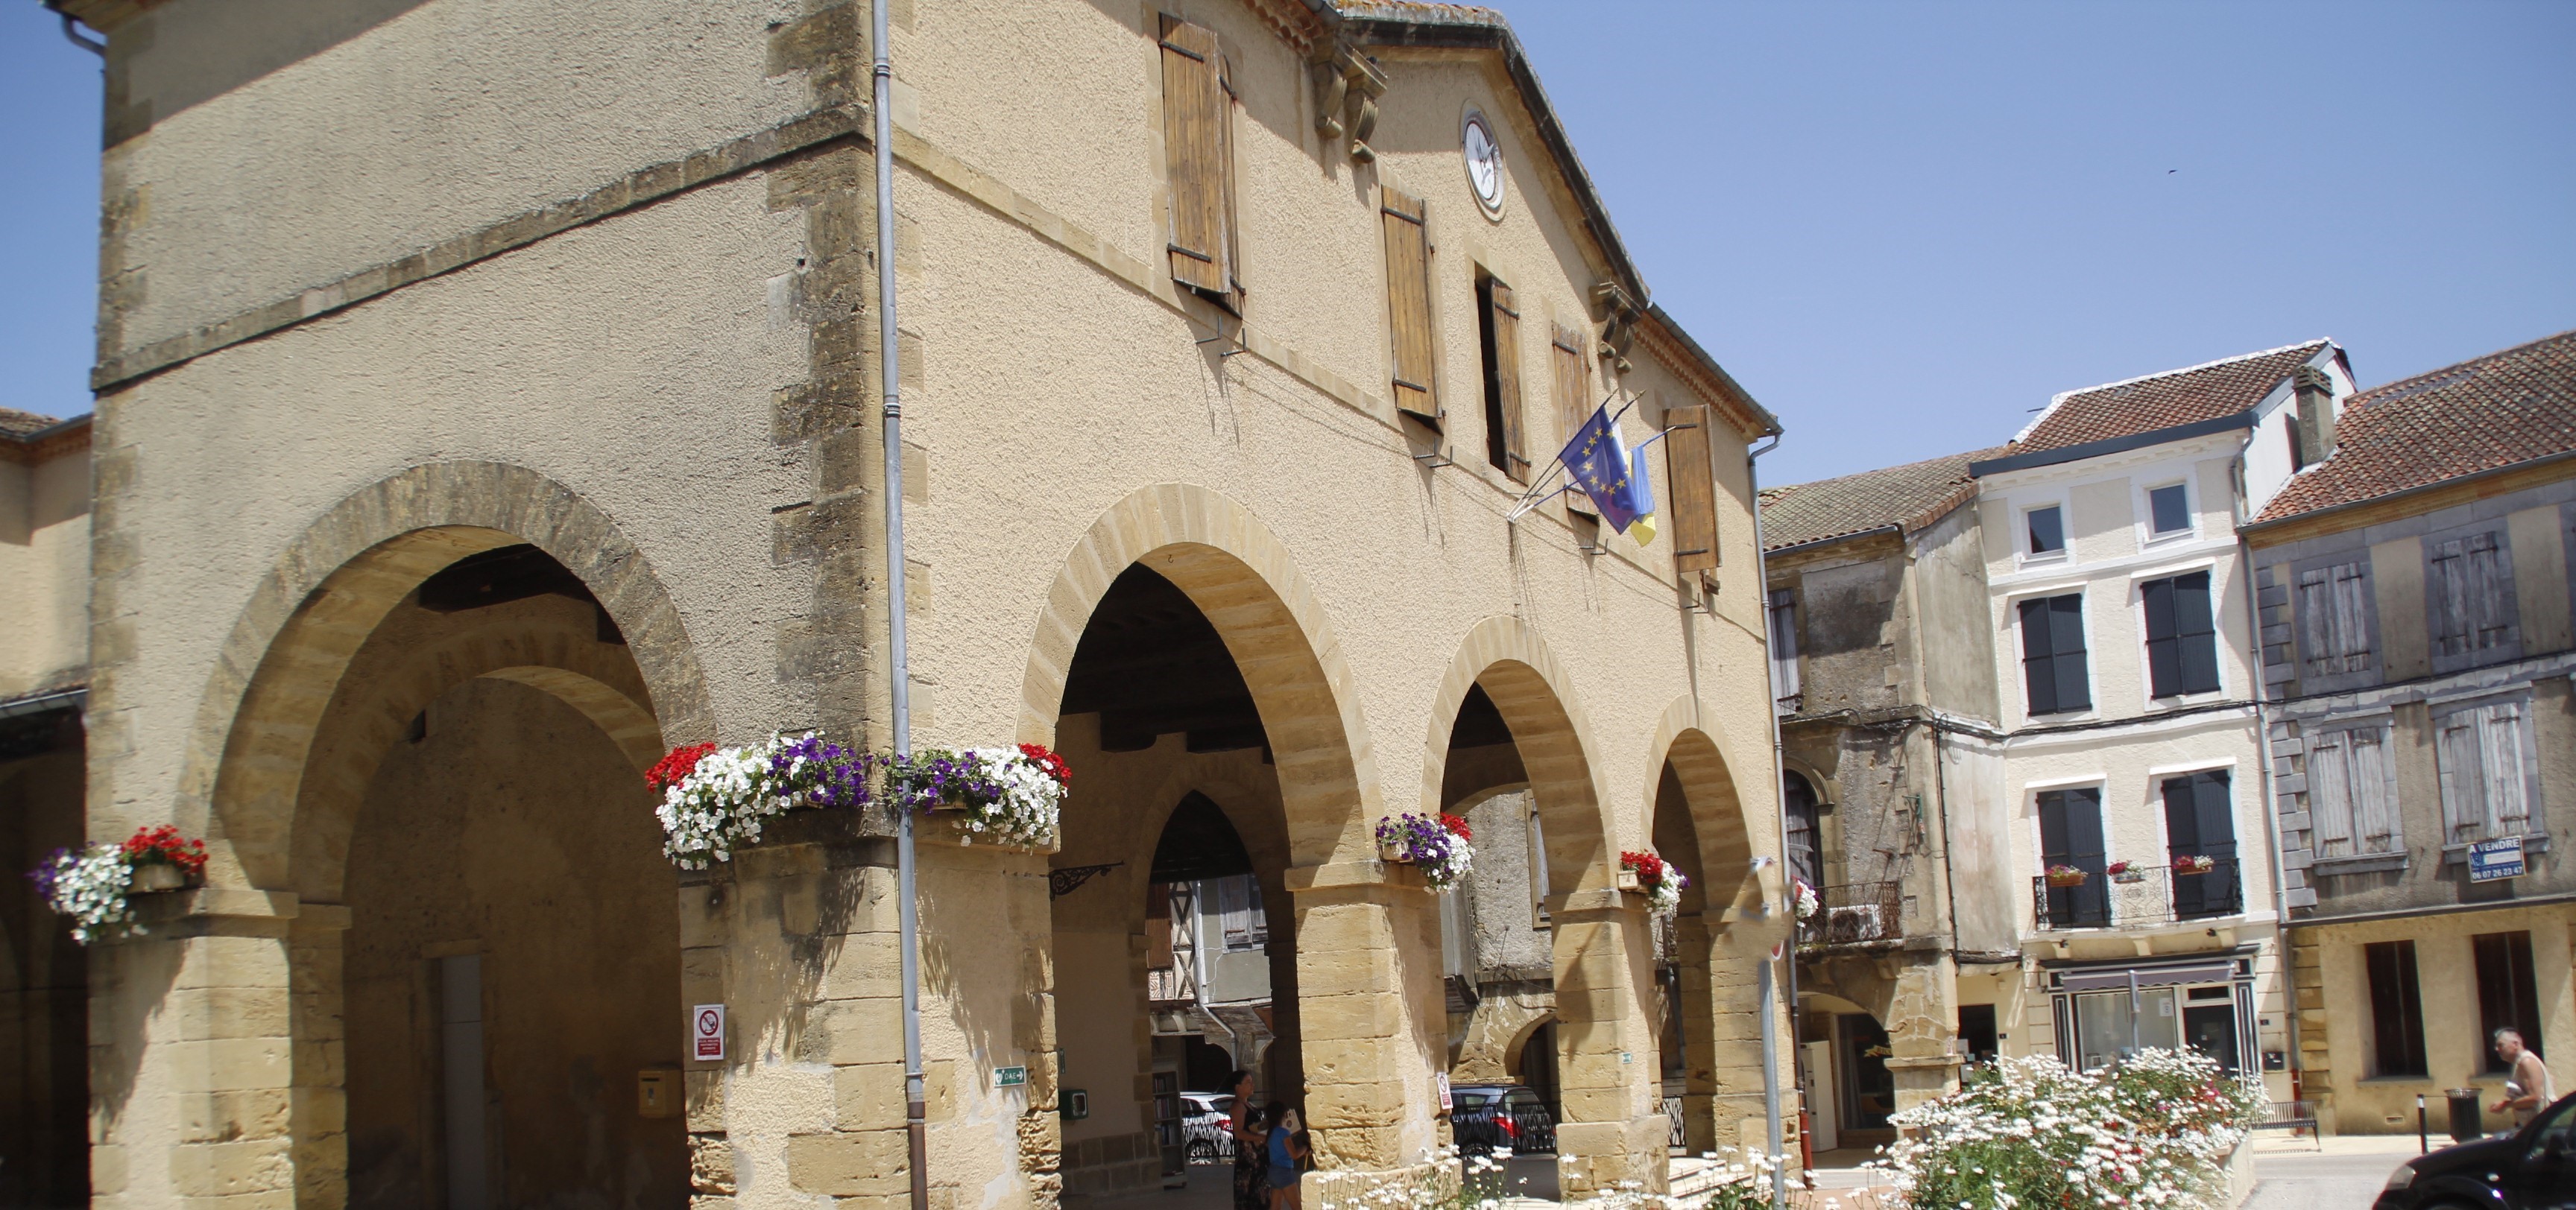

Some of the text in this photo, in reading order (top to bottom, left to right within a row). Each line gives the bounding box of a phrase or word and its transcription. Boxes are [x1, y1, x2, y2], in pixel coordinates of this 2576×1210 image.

[2469, 839, 2519, 853] A VENDRE
[2493, 869, 2502, 877] 26
[2503, 867, 2512, 875] 23
